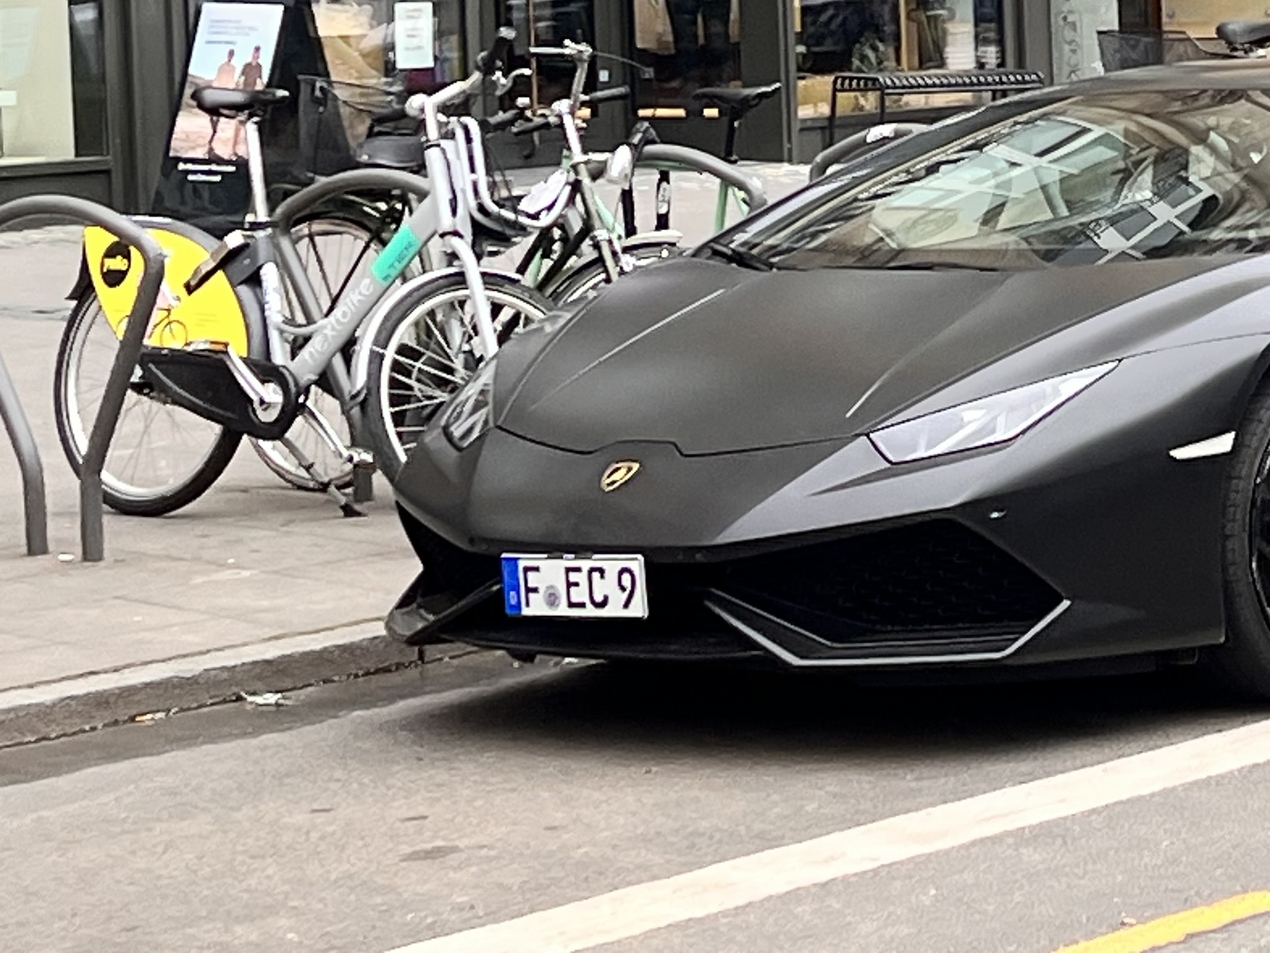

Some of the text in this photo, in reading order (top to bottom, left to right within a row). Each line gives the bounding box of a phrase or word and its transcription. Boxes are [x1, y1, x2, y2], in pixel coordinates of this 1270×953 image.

[522, 565, 637, 610] F EC 9
